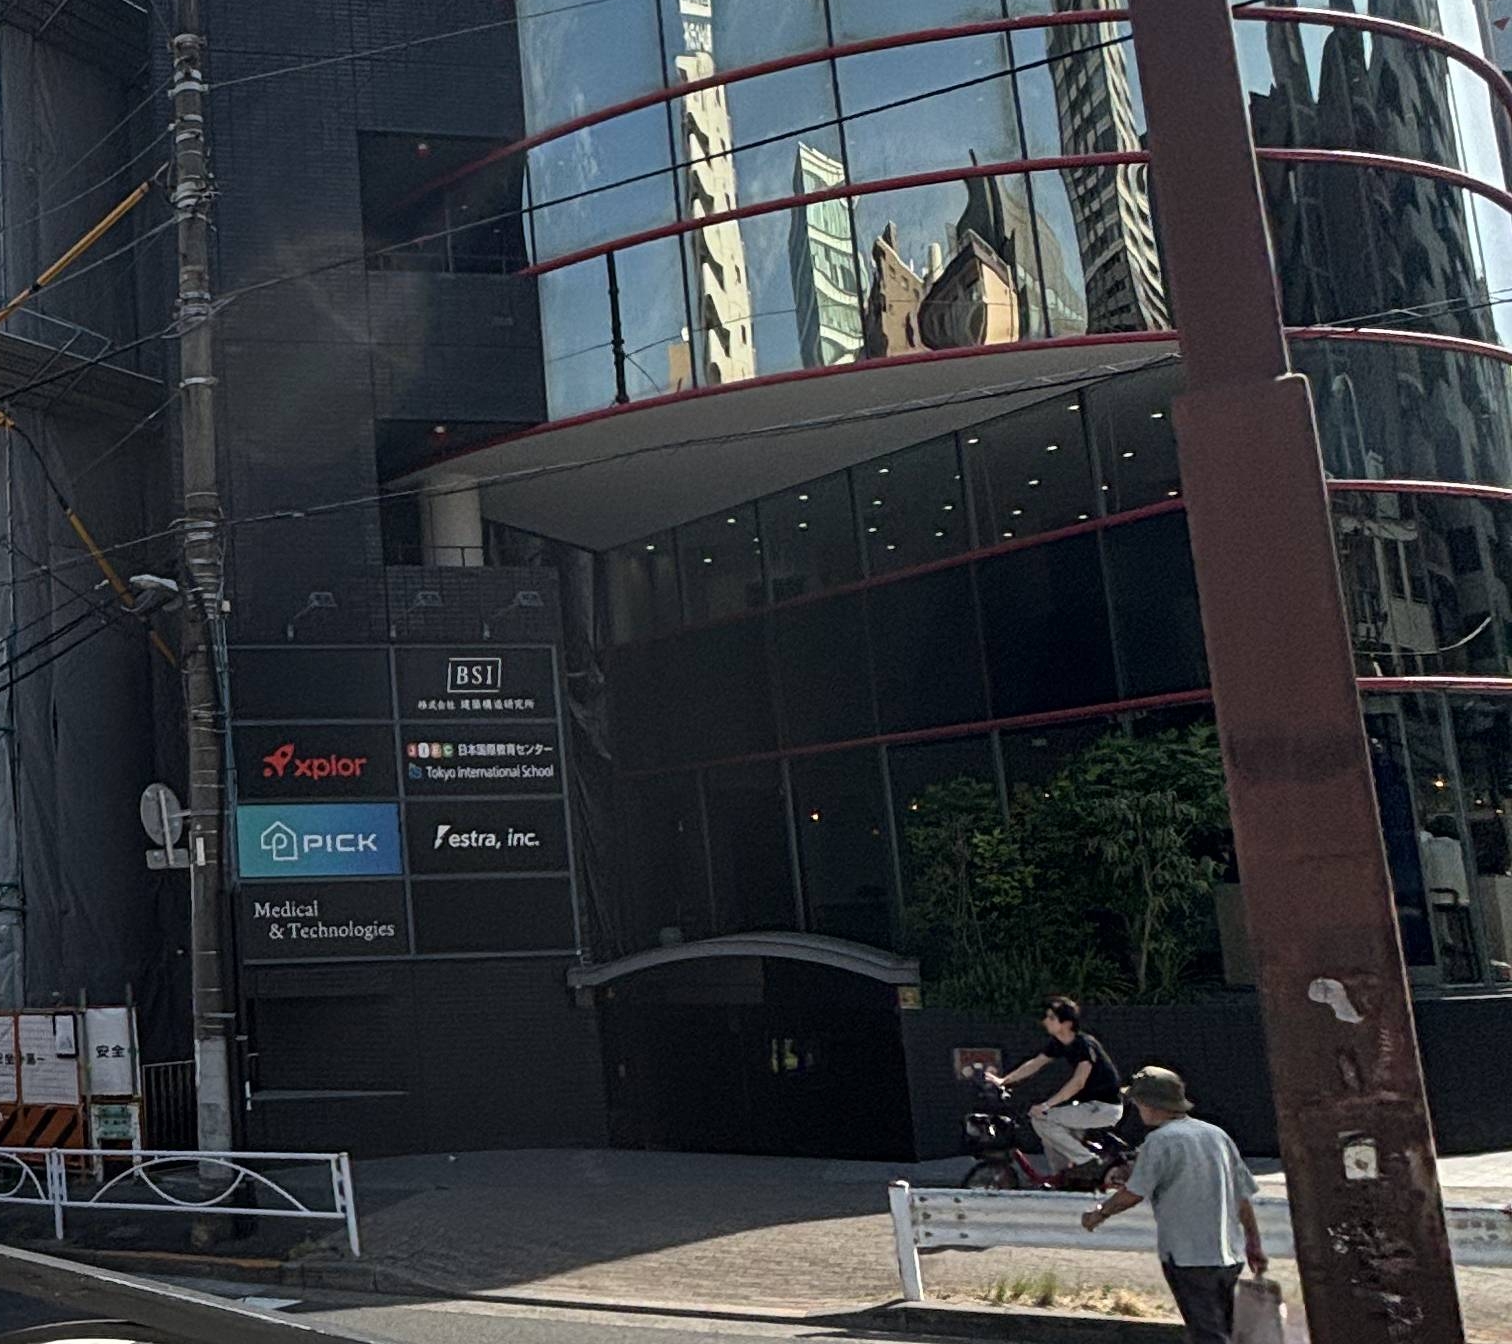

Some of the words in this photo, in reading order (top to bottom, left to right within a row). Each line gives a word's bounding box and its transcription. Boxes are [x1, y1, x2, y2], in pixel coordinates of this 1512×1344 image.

[456, 665, 493, 685] BSI
[417, 699, 456, 710] 株式会社
[458, 743, 553, 756] 日本国際教育センター
[426, 766, 455, 781] Tokyo
[522, 763, 554, 778] School
[303, 832, 378, 853] PICK
[507, 828, 540, 848] inc.
[253, 899, 319, 918] Medical
[268, 923, 285, 940] &
[287, 919, 396, 941] Technologies
[95, 1044, 126, 1059] 安全
